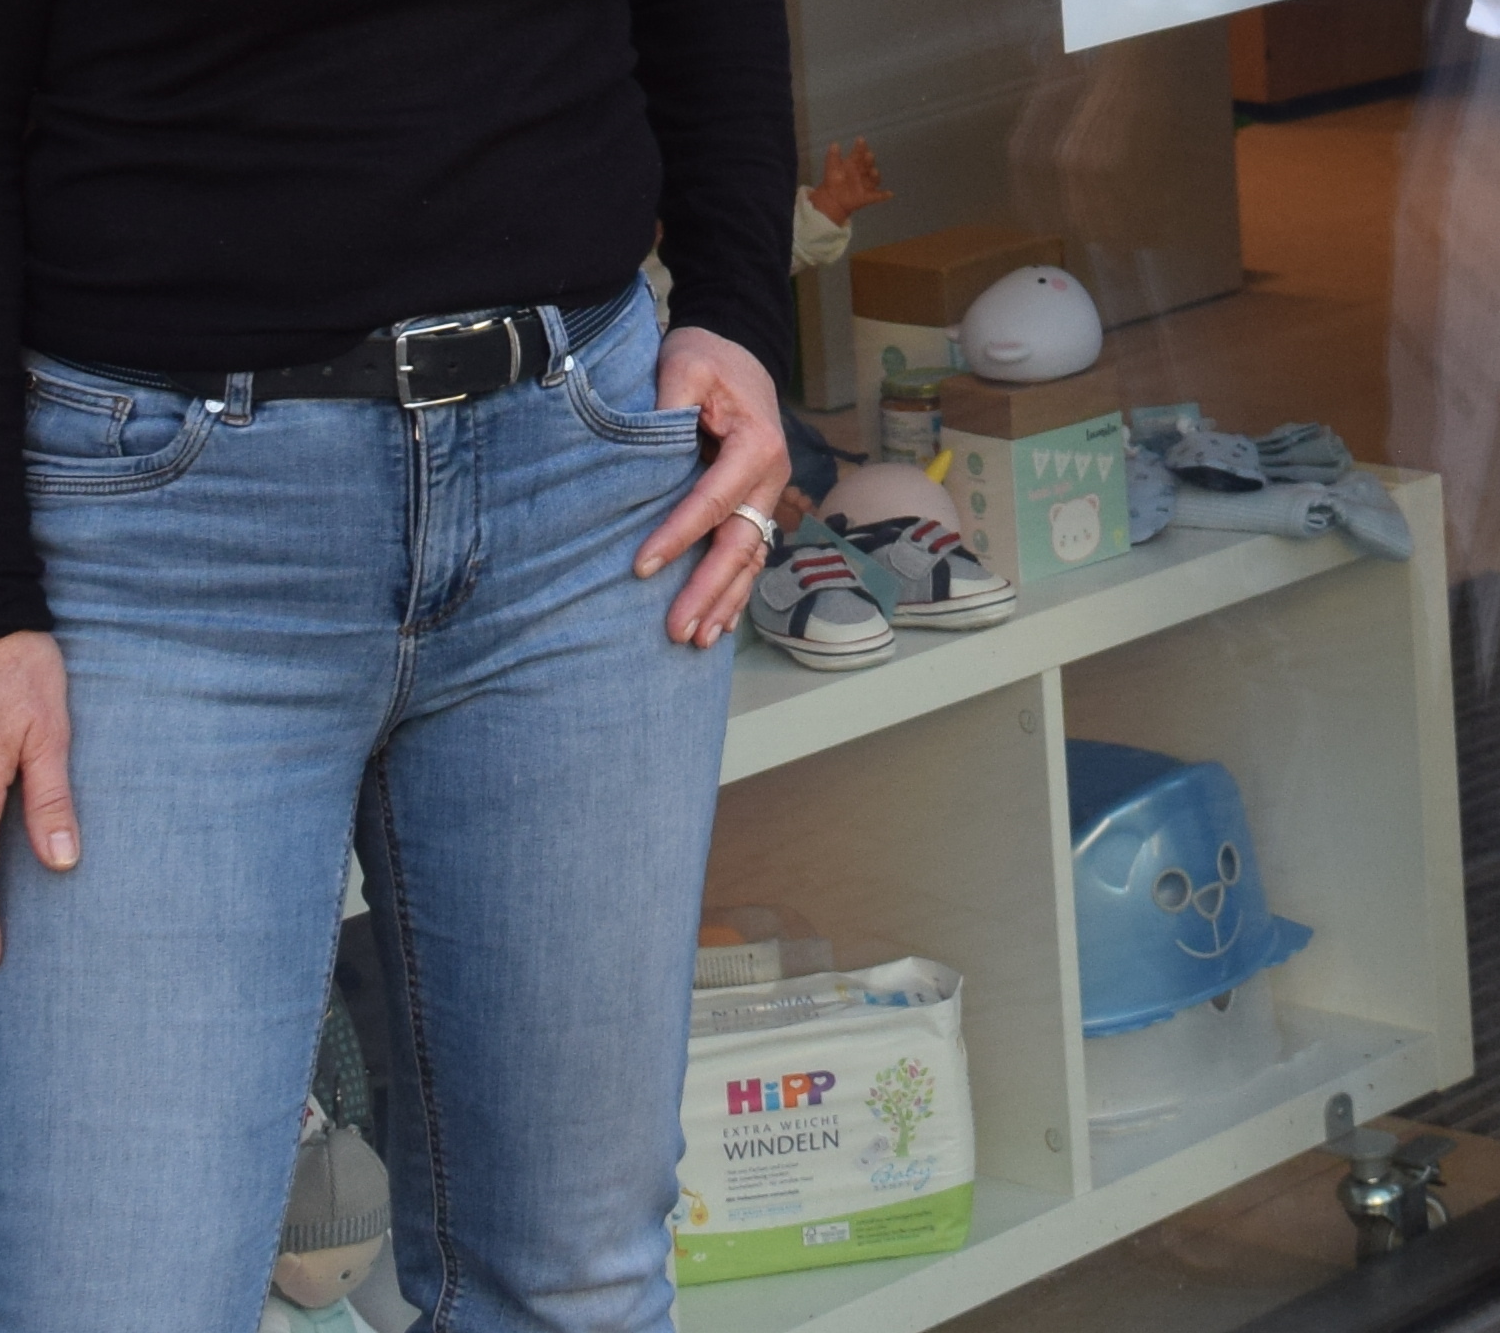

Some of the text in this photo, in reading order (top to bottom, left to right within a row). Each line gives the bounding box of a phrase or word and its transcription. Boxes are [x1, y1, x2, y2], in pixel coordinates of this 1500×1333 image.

[726, 1070, 837, 1115] HiPP
[723, 1114, 840, 1139] EXTRA WEICHE
[723, 1129, 840, 1162] WINDELN
